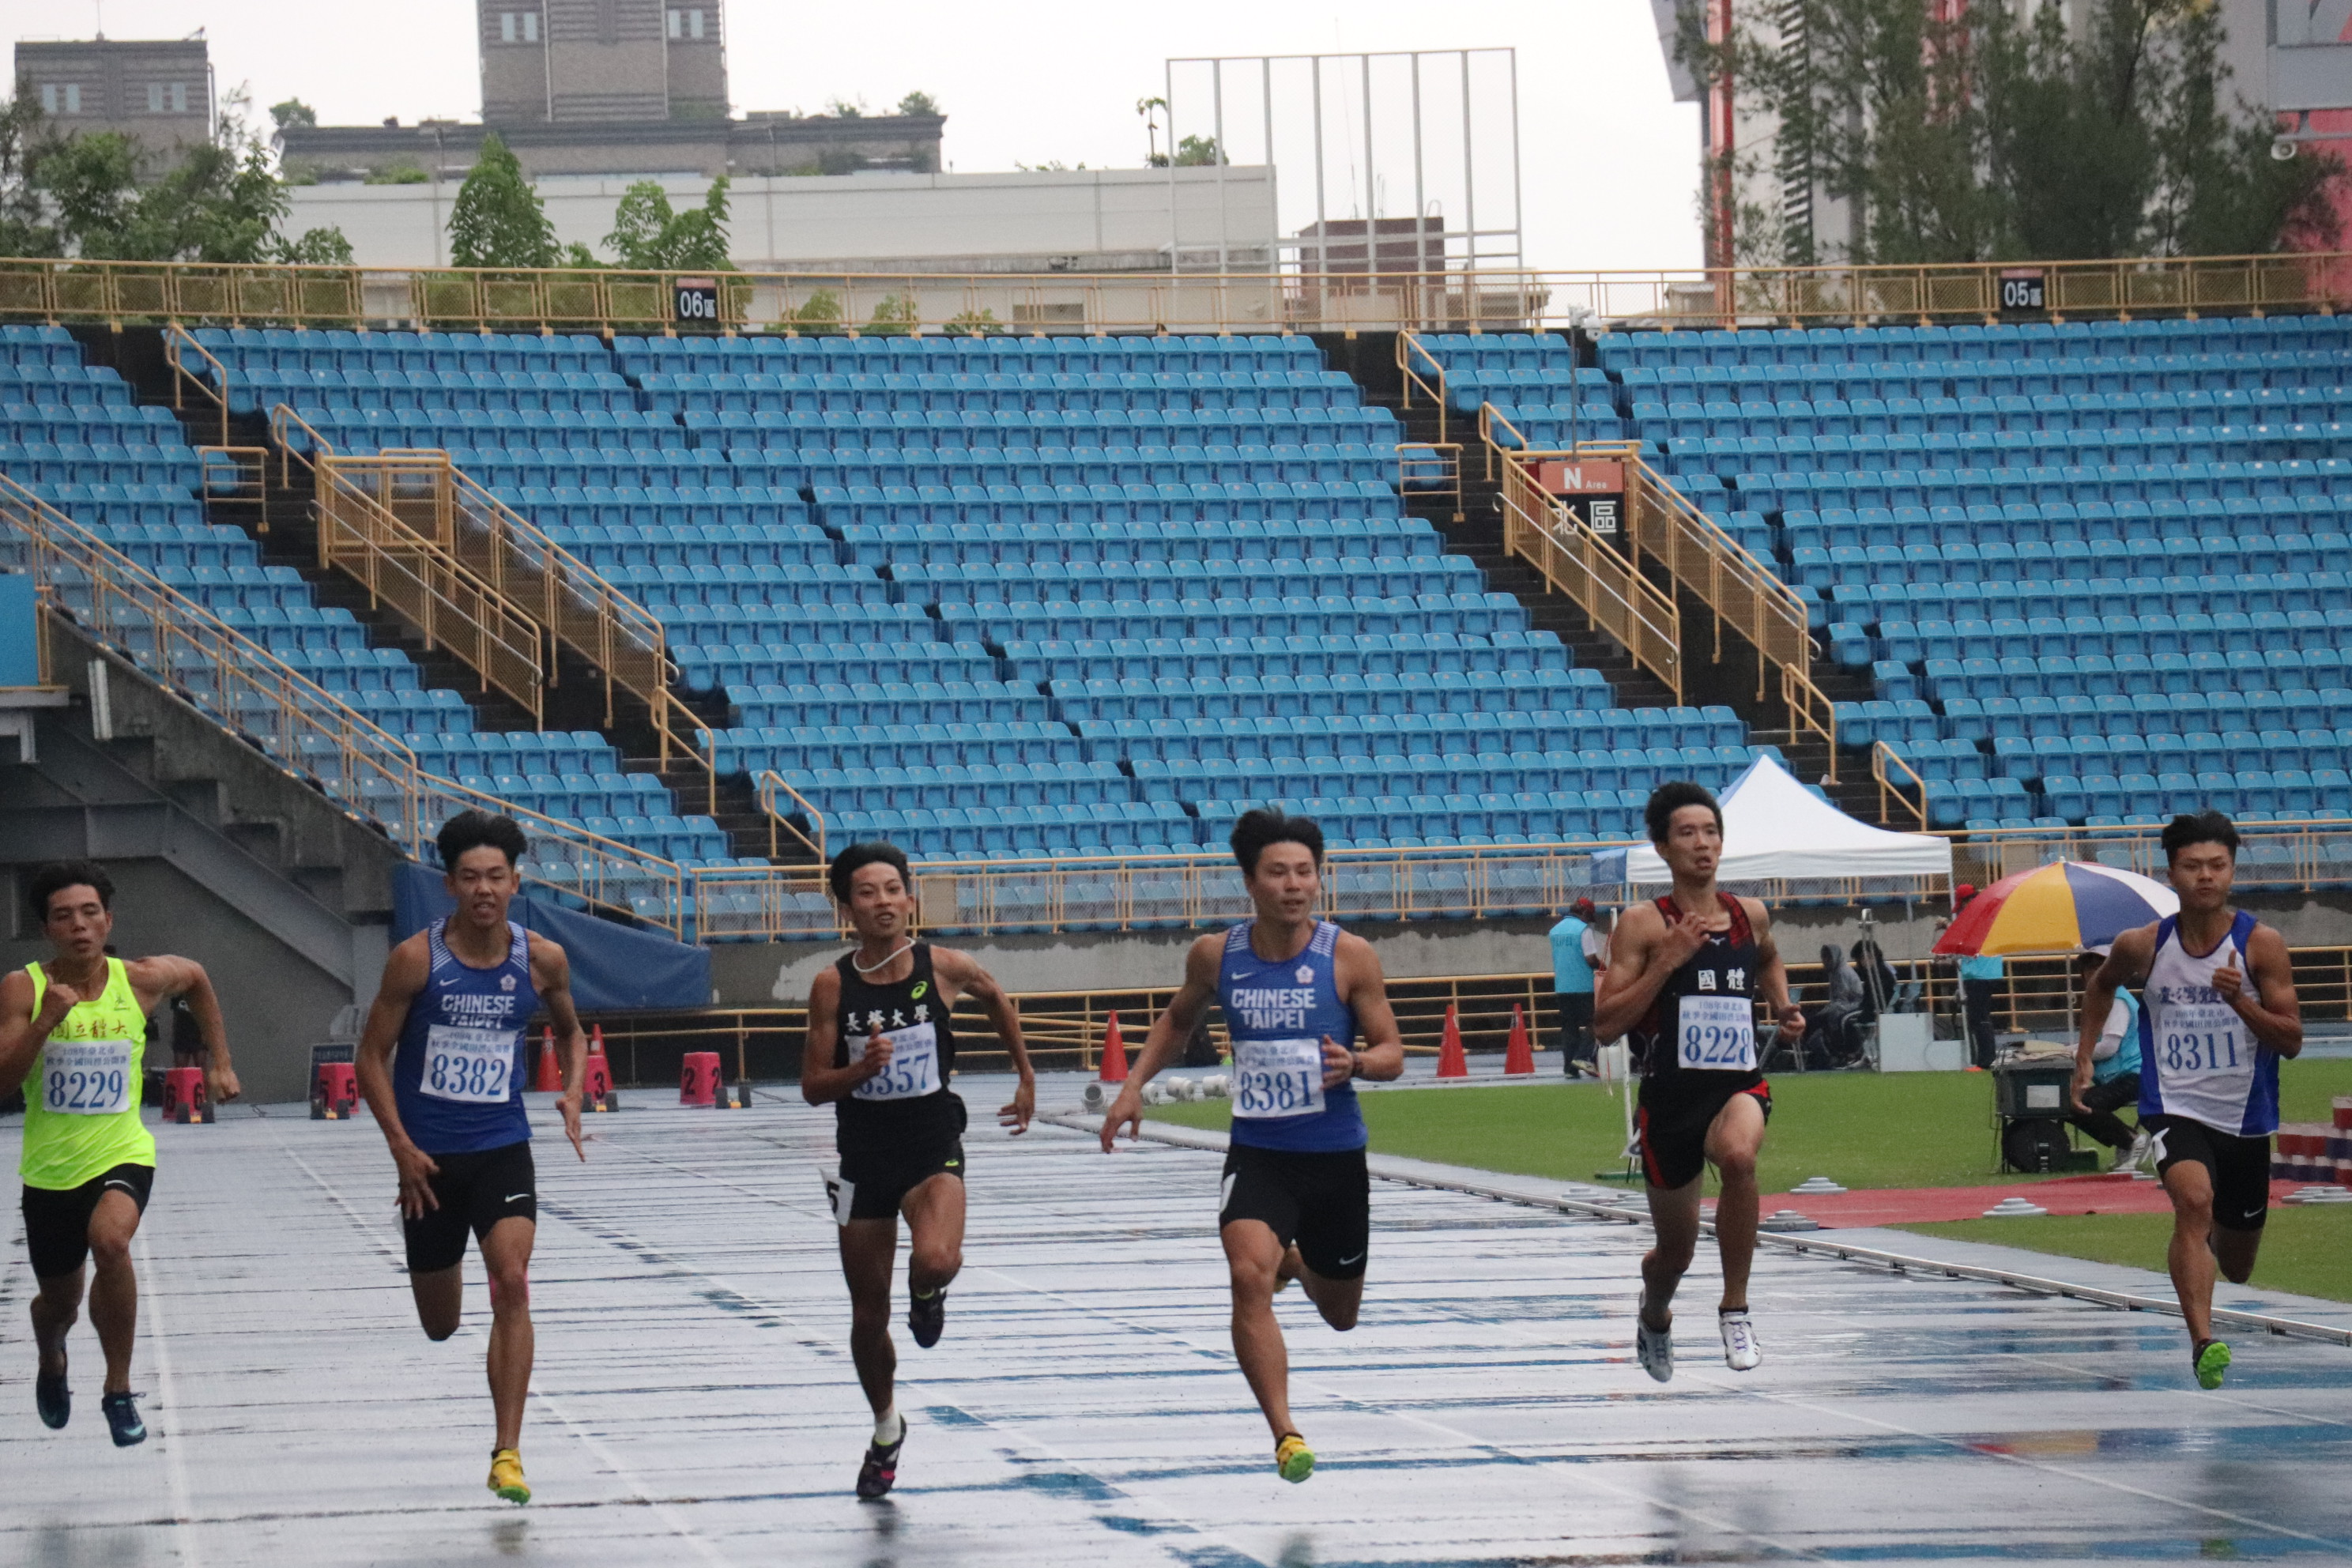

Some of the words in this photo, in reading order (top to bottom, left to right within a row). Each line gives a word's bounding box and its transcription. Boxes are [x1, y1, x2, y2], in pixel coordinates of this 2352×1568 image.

[1564, 467, 1581, 489] N
[1585, 481, 1608, 489] Area
[1552, 500, 1616, 534] 北區
[1698, 967, 1745, 991] 國體
[441, 994, 515, 1014] CHINESE
[1231, 989, 1317, 1008] CHINESE
[1240, 1009, 1306, 1029] TAIPEI
[1684, 1025, 1751, 1064] 8228
[2167, 1031, 2239, 1070] 8311
[431, 1054, 506, 1095] 8382
[594, 1071, 605, 1099] 3
[684, 1067, 695, 1095] 2
[49, 1070, 122, 1108] 8229
[194, 1082, 203, 1110] 6
[346, 1078, 356, 1106] 5
[1240, 1071, 1314, 1111] 8381
[827, 1181, 839, 1214] 5
